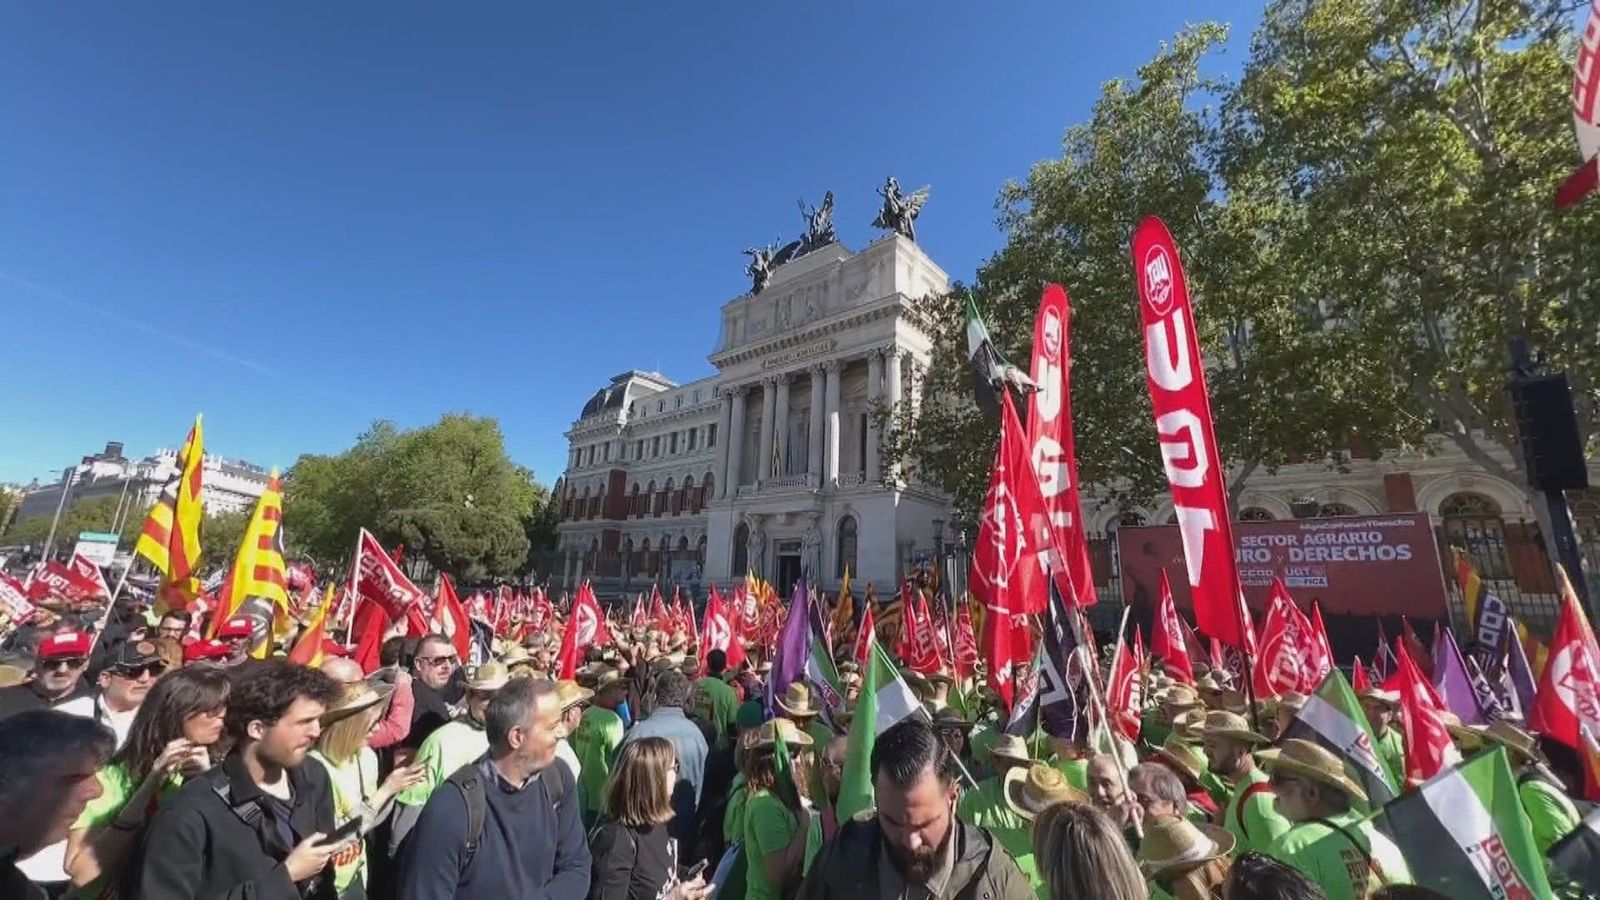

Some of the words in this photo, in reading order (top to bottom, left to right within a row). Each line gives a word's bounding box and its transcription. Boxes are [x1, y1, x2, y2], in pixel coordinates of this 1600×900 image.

[1241, 534, 1298, 547] SECTOR
[1303, 530, 1383, 545] AGRARIO
[1289, 544, 1412, 562] DERECHOS
[1285, 568, 1311, 576] UGT
[1483, 837, 1522, 889] UGT
